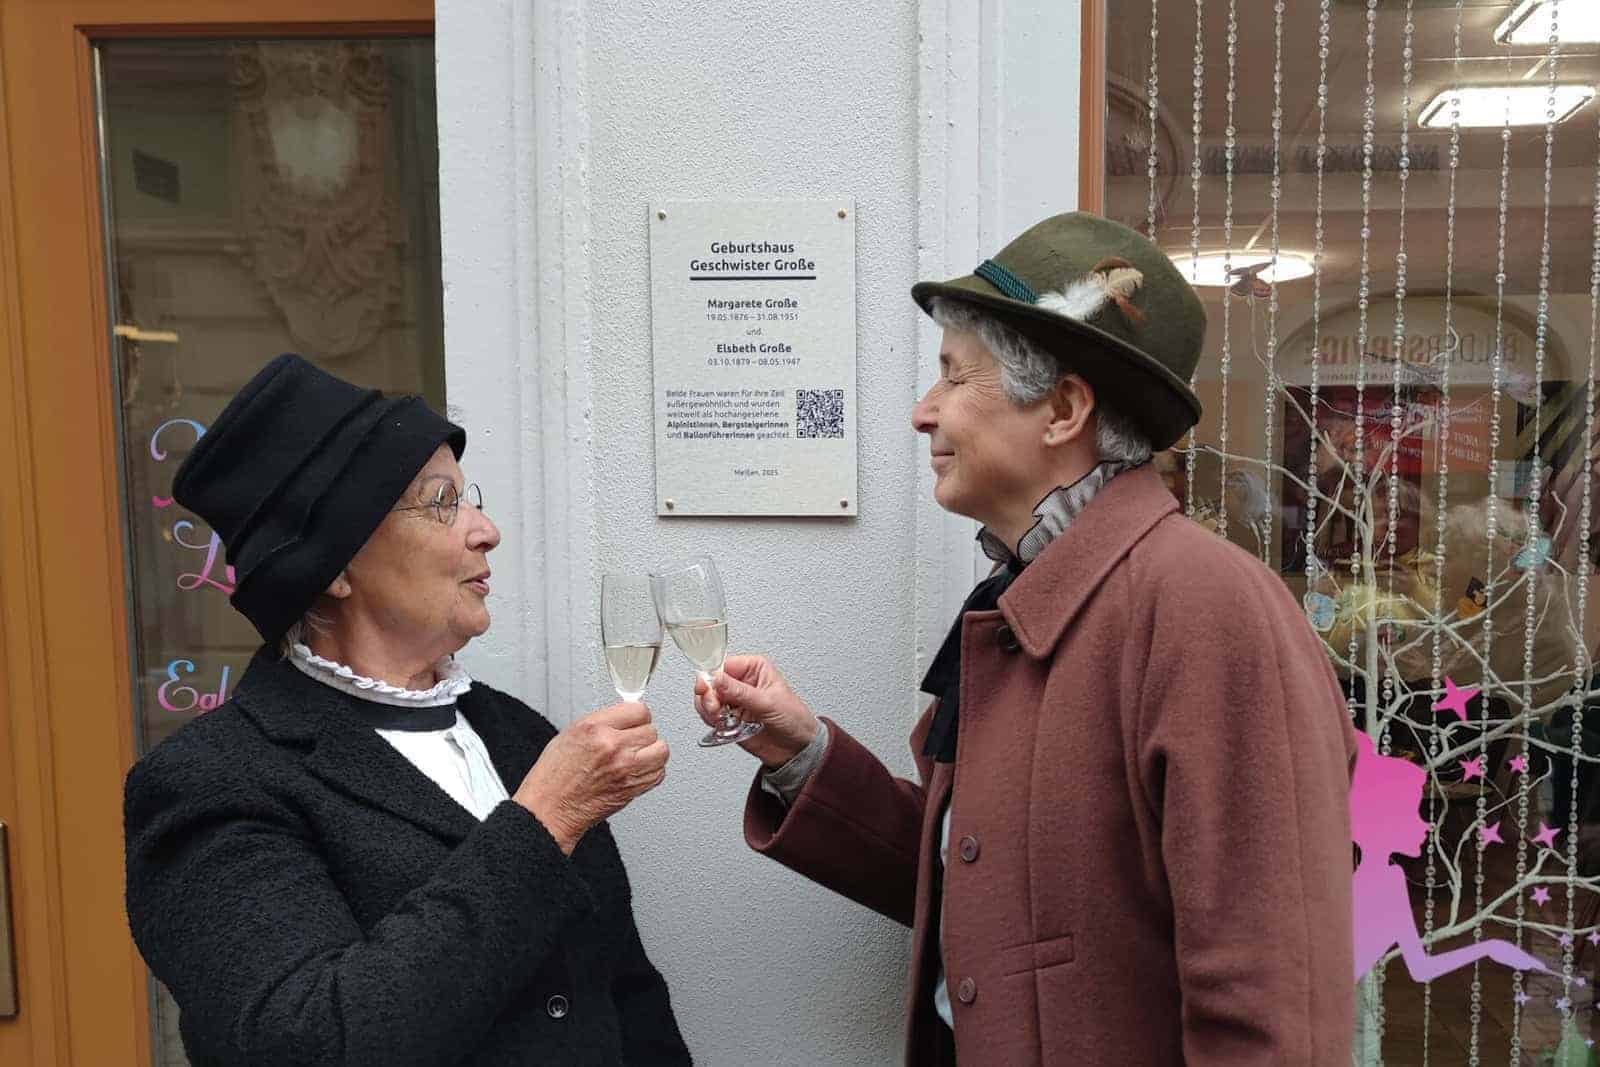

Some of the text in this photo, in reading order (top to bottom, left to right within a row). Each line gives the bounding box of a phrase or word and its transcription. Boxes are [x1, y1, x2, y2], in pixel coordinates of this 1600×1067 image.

[711, 242, 795, 254] Geburtshaus
[690, 258, 816, 271] Geschwister Große
[707, 298, 798, 310] Margarete Große
[706, 313, 748, 321] 19.05.1876
[757, 313, 799, 321] 31.08.1951
[745, 327, 762, 336] und
[716, 343, 792, 353] Elsbeth Große
[707, 358, 750, 366] 03.10.1879
[666, 389, 687, 397] Beide
[689, 389, 716, 397] Frauen
[741, 388, 752, 397] für
[770, 389, 785, 397] Zeit
[667, 400, 780, 409] außergewöhnlich und wurden
[702, 410, 713, 418] als
[714, 410, 780, 420] hochangesehene
[667, 431, 682, 439] und
